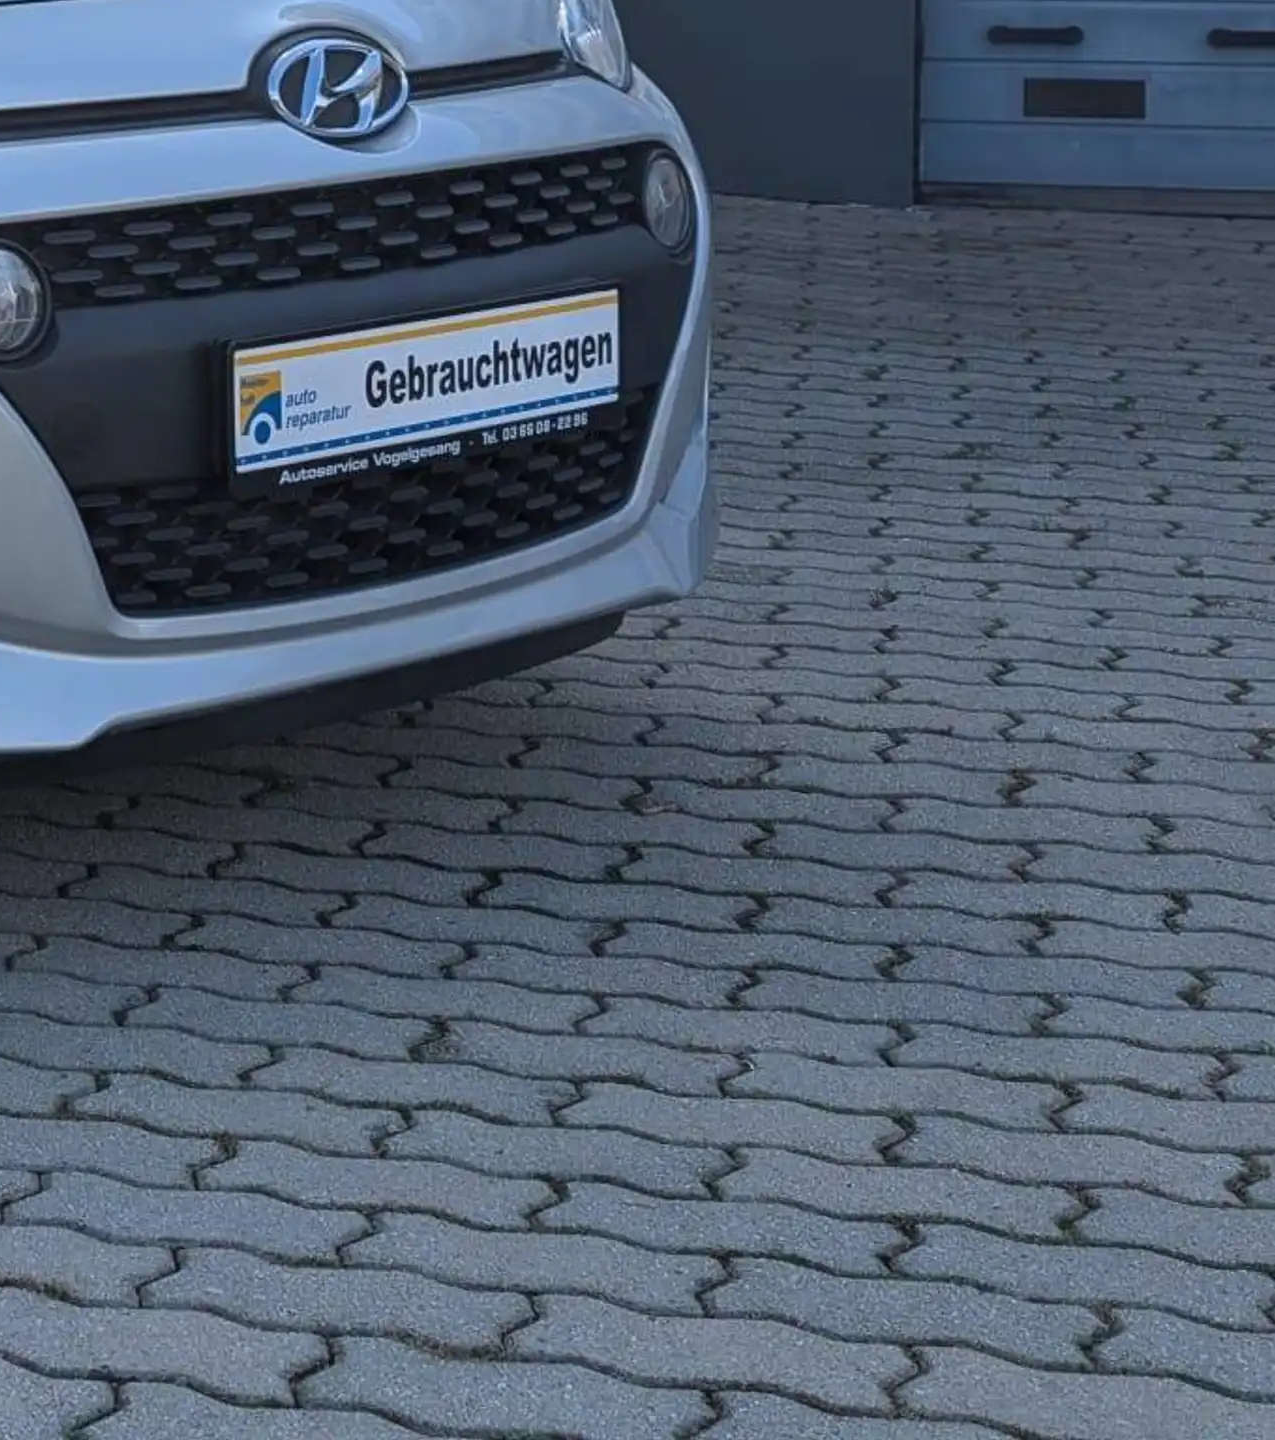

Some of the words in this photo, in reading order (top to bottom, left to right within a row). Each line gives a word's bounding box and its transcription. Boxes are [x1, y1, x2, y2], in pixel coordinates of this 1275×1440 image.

[365, 331, 613, 409] Gebrauchtwagen
[285, 389, 317, 408] auto
[285, 405, 352, 431] reparatur
[278, 458, 369, 486] Autoservice
[373, 440, 461, 467] Vogelgesang
